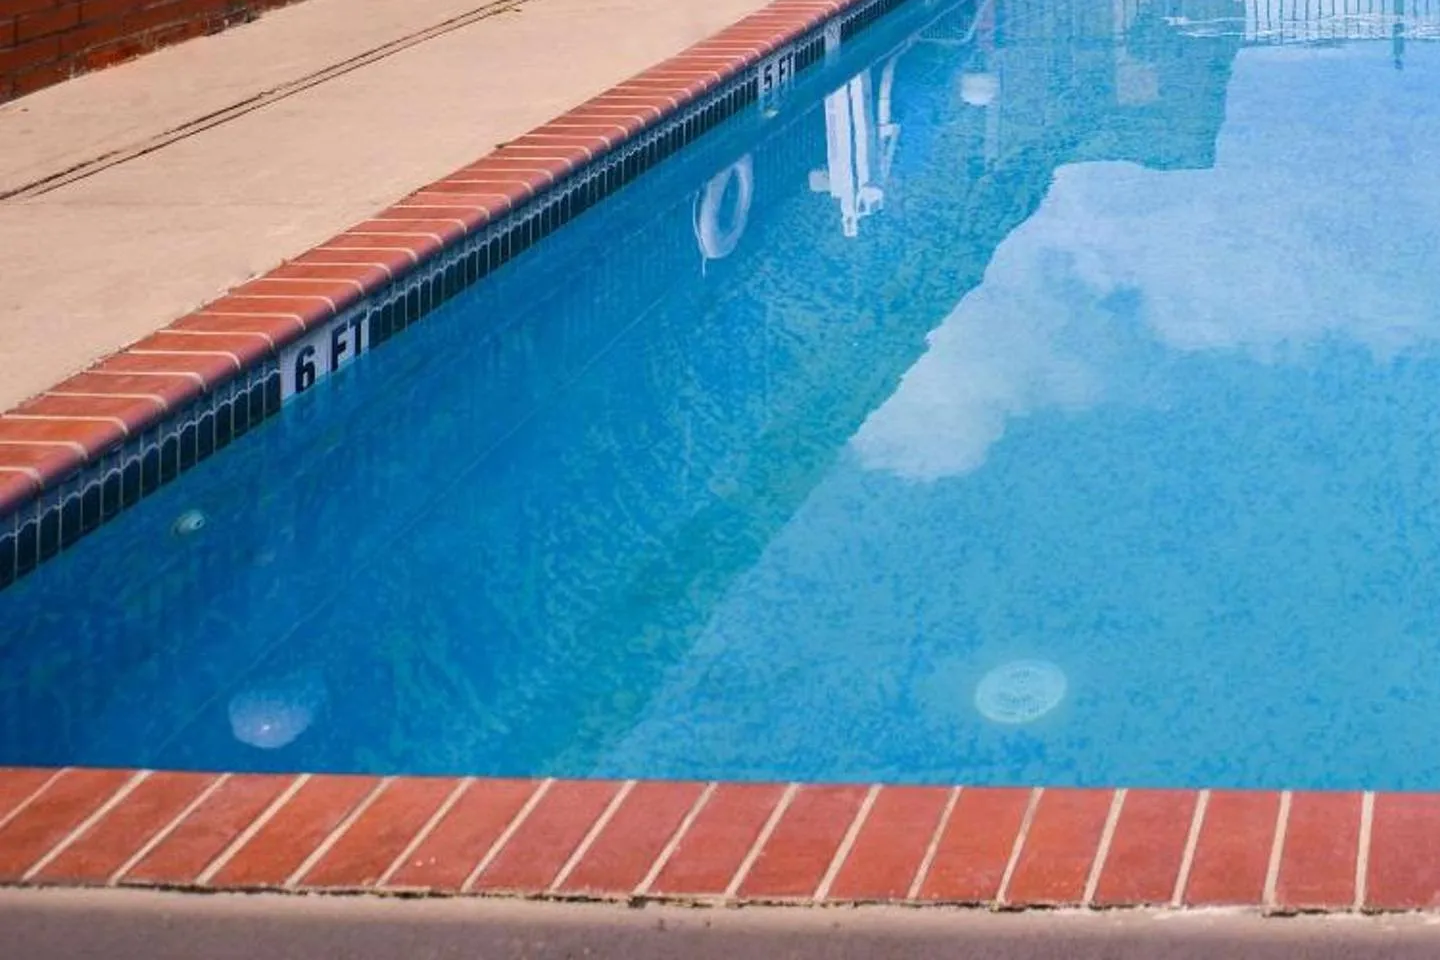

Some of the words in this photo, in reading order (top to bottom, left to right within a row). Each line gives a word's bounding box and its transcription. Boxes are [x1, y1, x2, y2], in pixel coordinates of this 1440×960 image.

[764, 63, 773, 92] 5
[779, 52, 793, 83] FT
[295, 344, 316, 394] 6
[331, 308, 368, 372] FT
